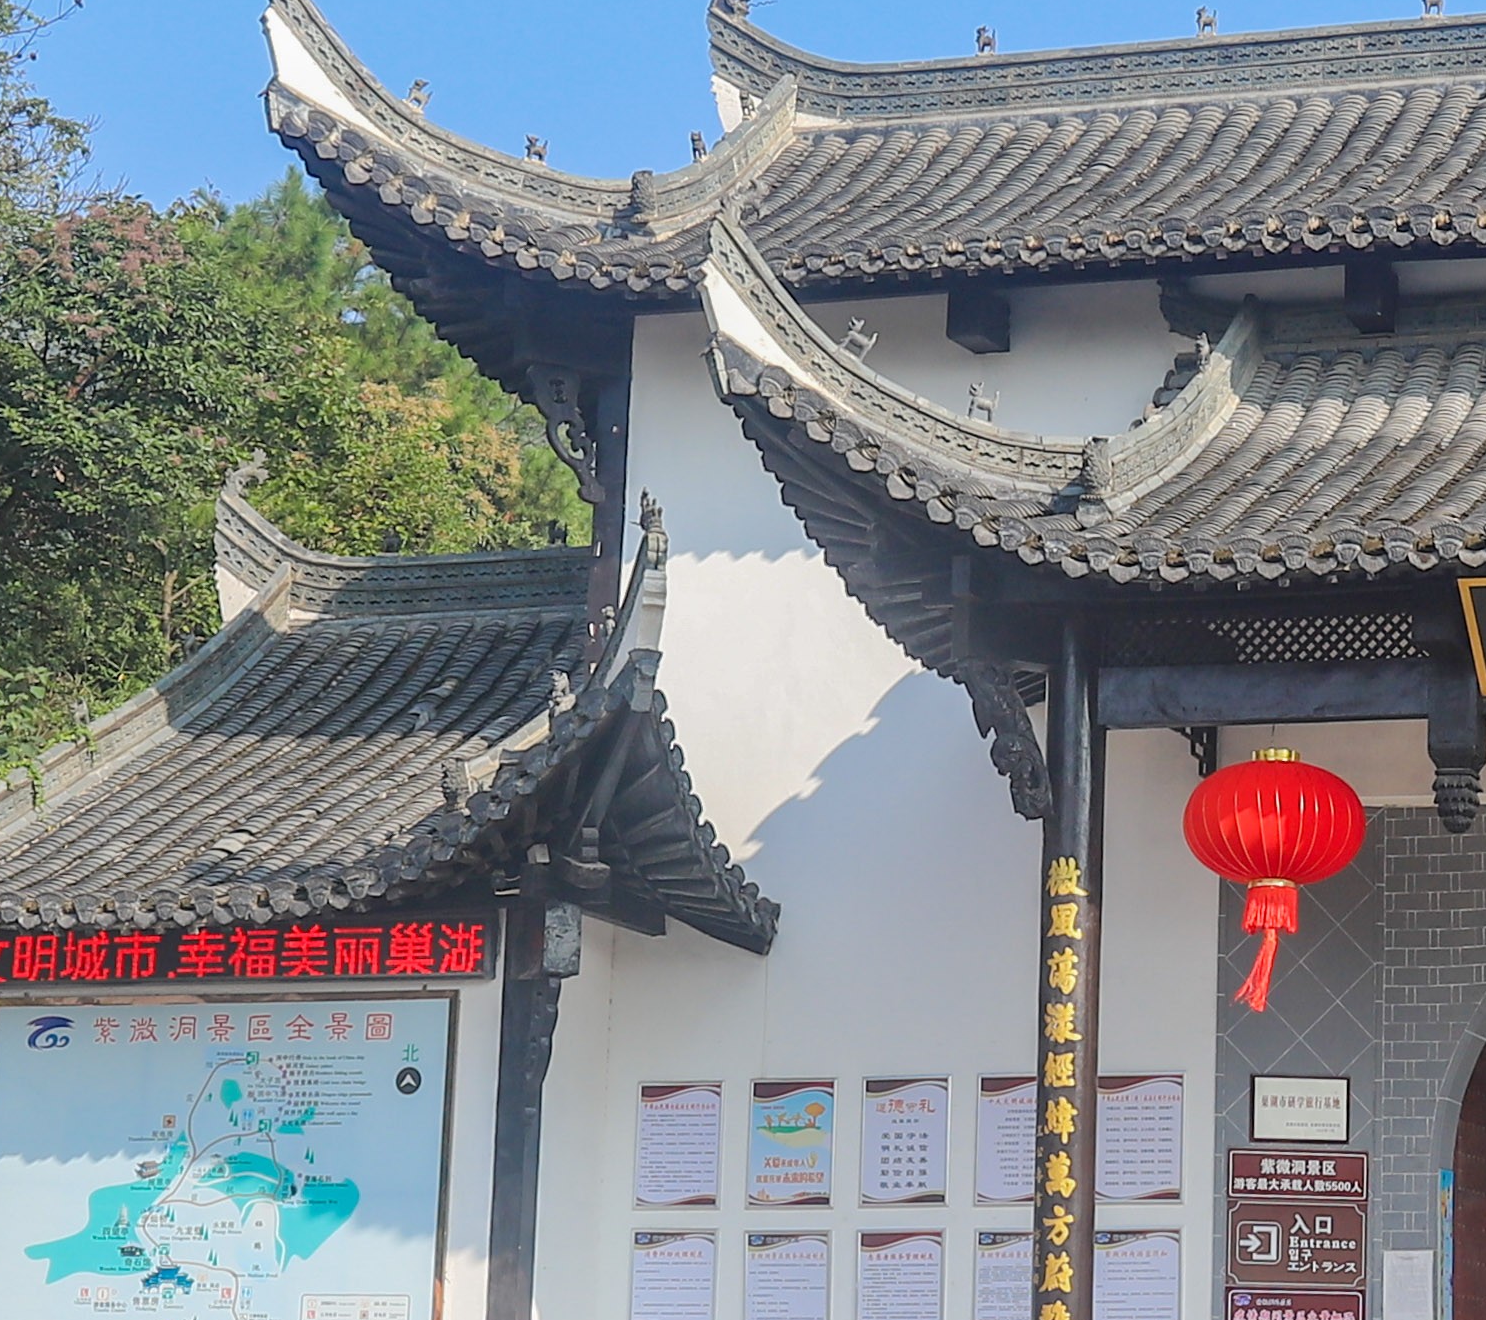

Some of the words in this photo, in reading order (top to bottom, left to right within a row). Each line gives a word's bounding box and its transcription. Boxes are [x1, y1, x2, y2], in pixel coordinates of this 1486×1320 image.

[402, 1044, 420, 1063] 北
[1261, 1095, 1341, 1110] 巢湖市研学旅行基地
[1260, 1158, 1336, 1176] 紫微洞景区
[1233, 1177, 1362, 1194] 游客最大承载人数5500人
[1289, 1213, 1333, 1235] 入口
[1288, 1236, 1357, 1249] Entrance
[1288, 1249, 1313, 1262] 입구
[1287, 1261, 1358, 1274] エントランス
